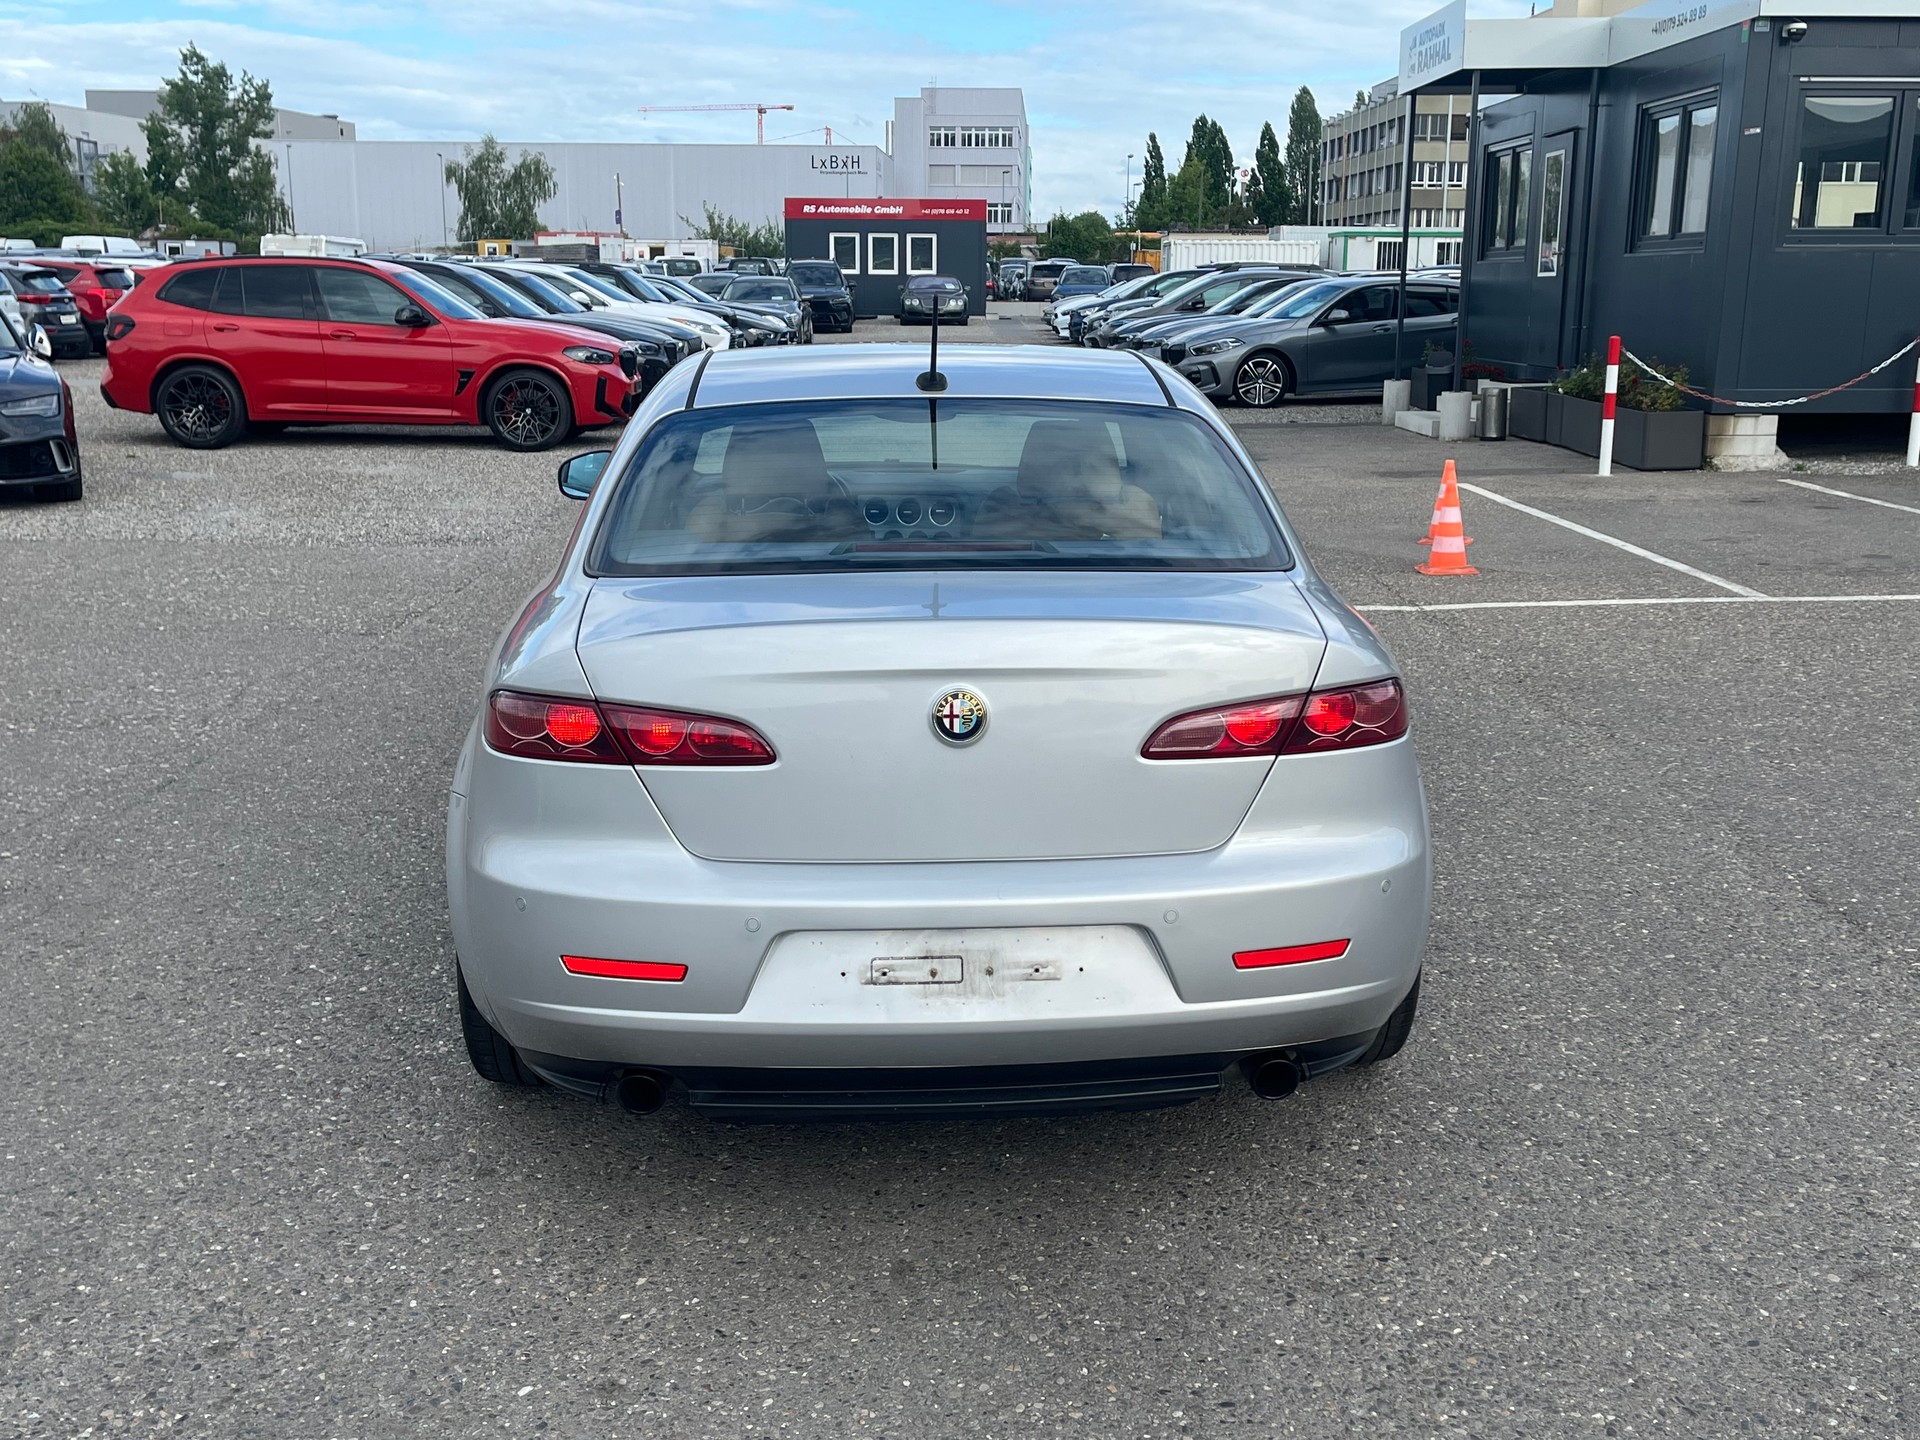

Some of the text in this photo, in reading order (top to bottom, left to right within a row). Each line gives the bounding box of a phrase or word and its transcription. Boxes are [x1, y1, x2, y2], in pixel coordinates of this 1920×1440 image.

[1676, 11, 1688, 27] 324
[1689, 8, 1698, 23] 89
[1699, 4, 1707, 20] 89
[1418, 20, 1446, 46] AUTOPARK
[1417, 36, 1452, 74] RAHHAL
[803, 205, 904, 215] RS Automobile GmbH
[937, 692, 983, 718] ALFA ROMEO
